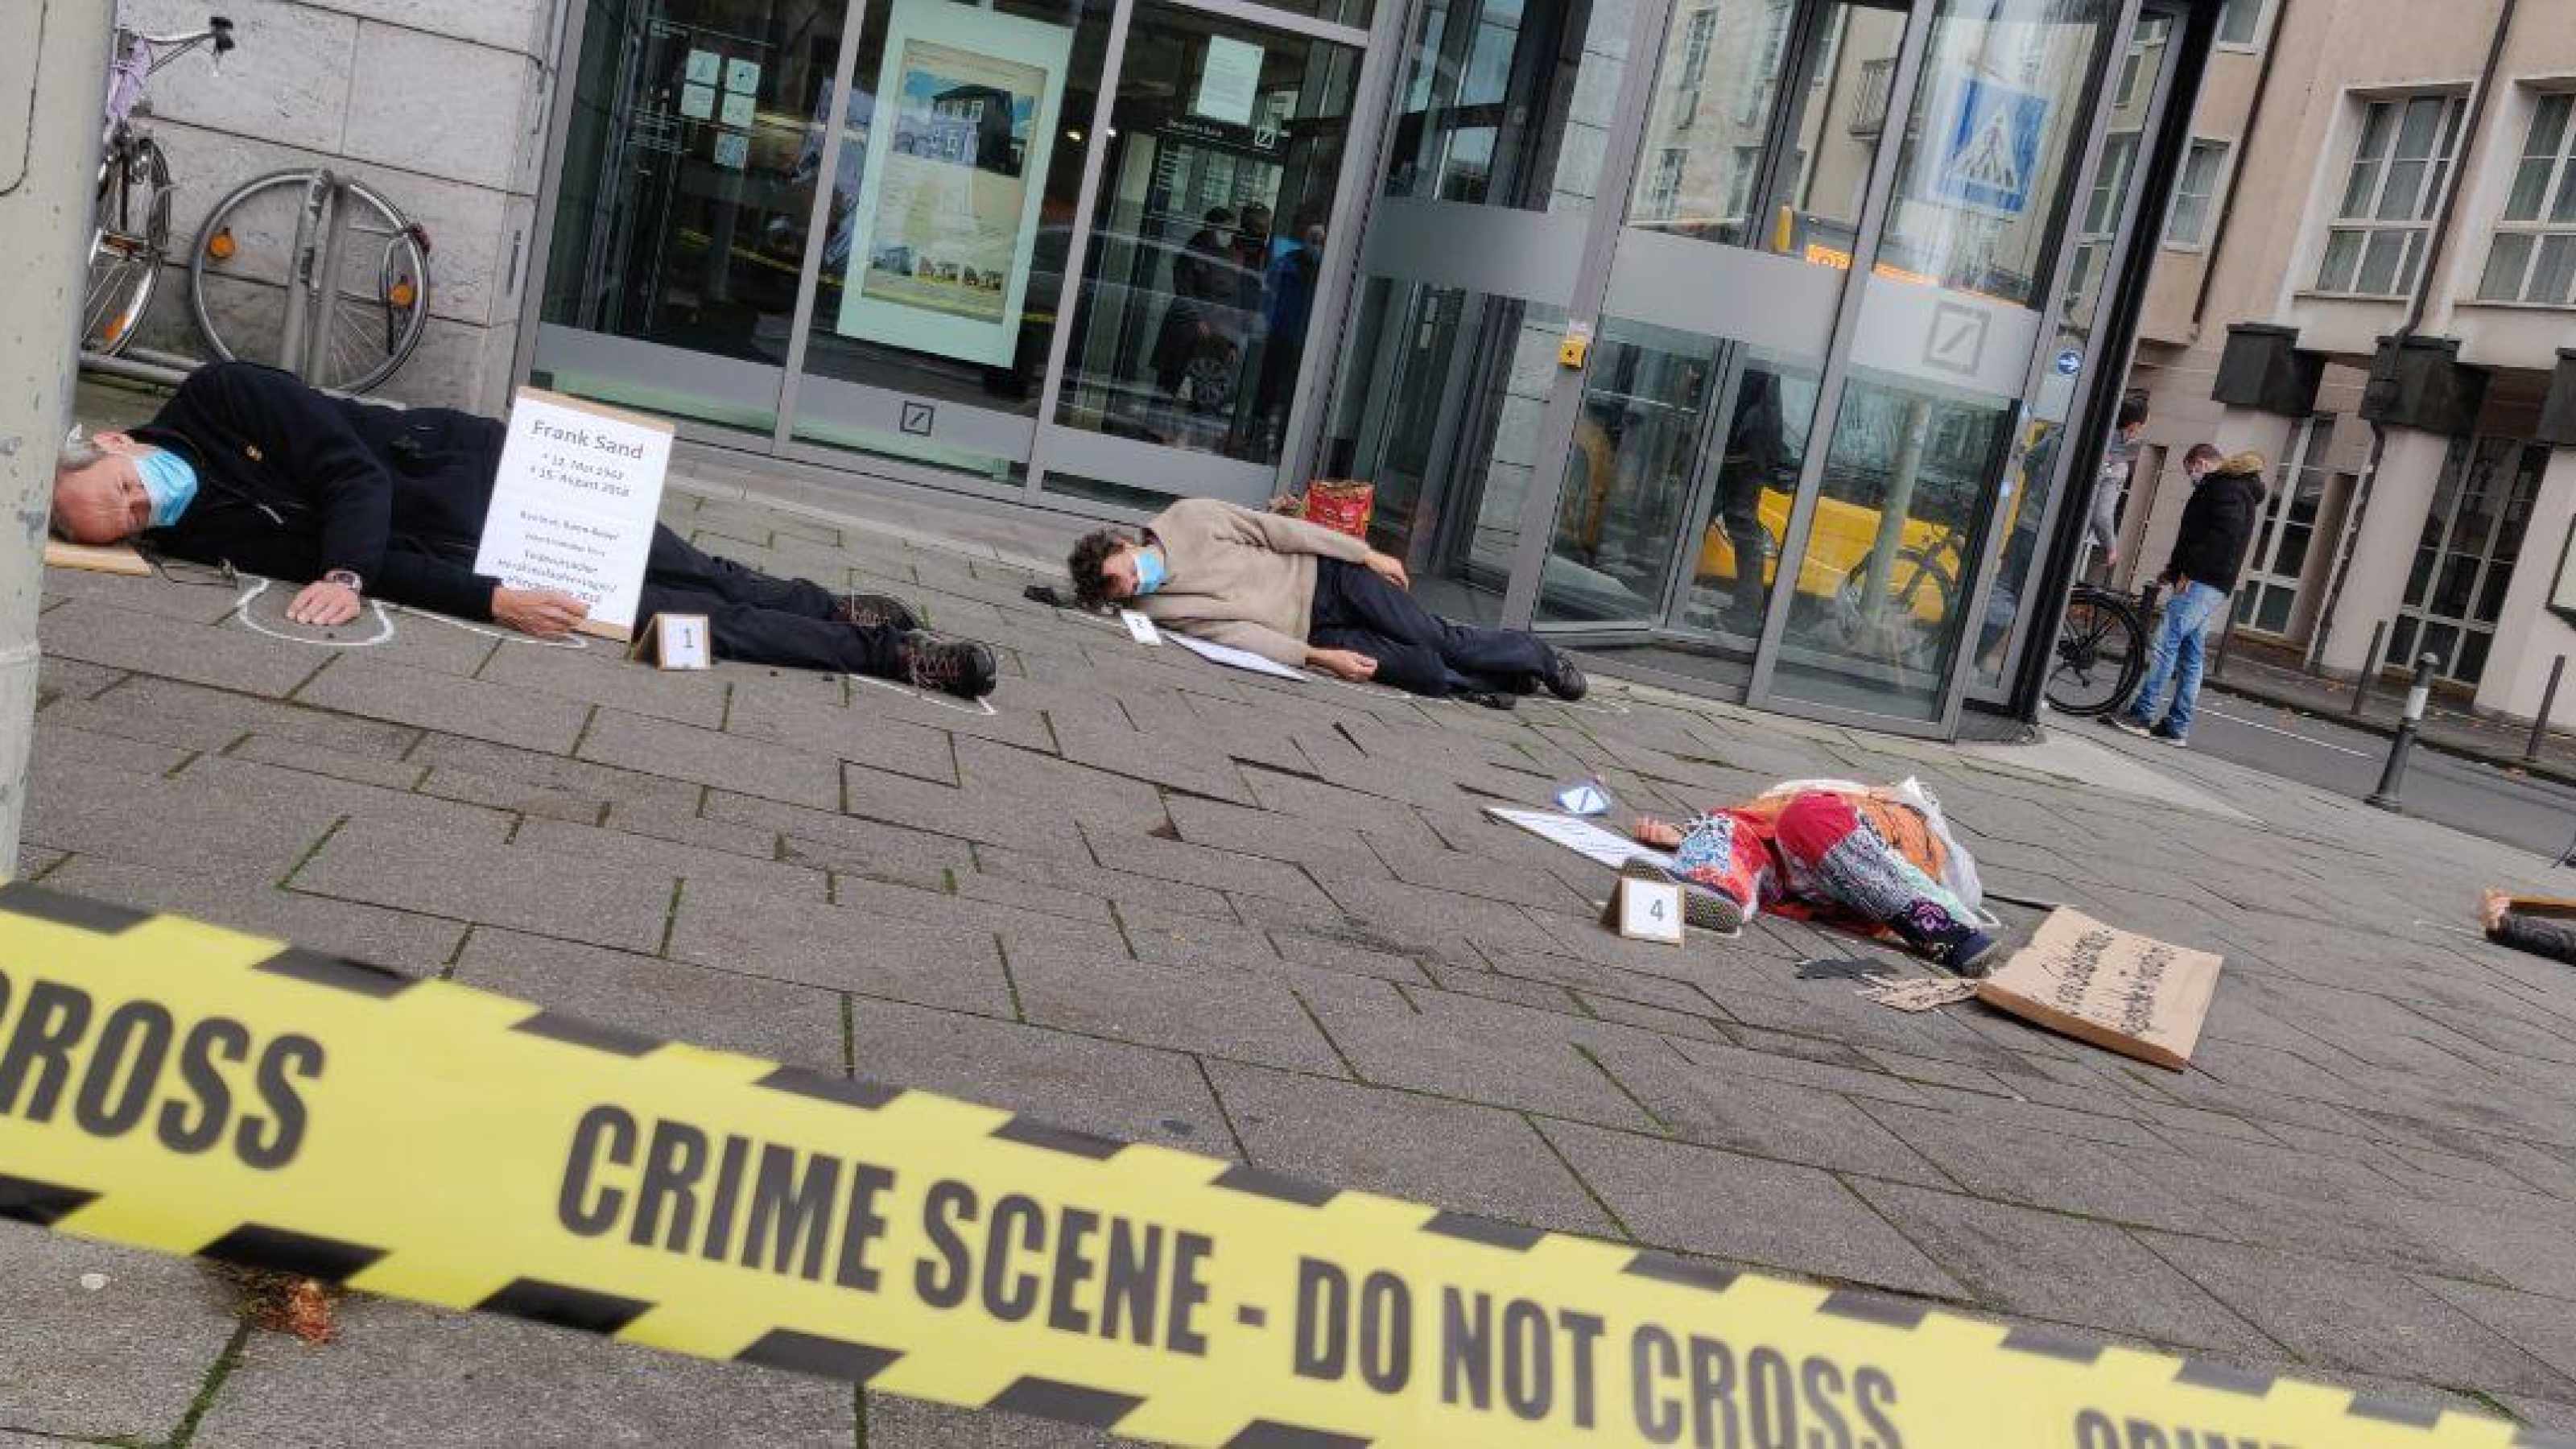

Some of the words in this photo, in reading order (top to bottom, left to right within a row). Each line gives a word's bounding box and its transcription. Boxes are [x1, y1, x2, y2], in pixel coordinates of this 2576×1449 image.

[530, 419, 590, 448] Frank
[593, 435, 644, 460] Sand
[683, 625, 695, 649] 1
[1649, 898, 1664, 922] 4
[0, 969, 325, 1171] ROSS
[558, 1103, 898, 1294] CRIME
[914, 1179, 1213, 1356] SCENE
[1293, 1255, 1414, 1394] DO
[1440, 1285, 1608, 1430] NOT
[1630, 1323, 1905, 1449] CROSS
